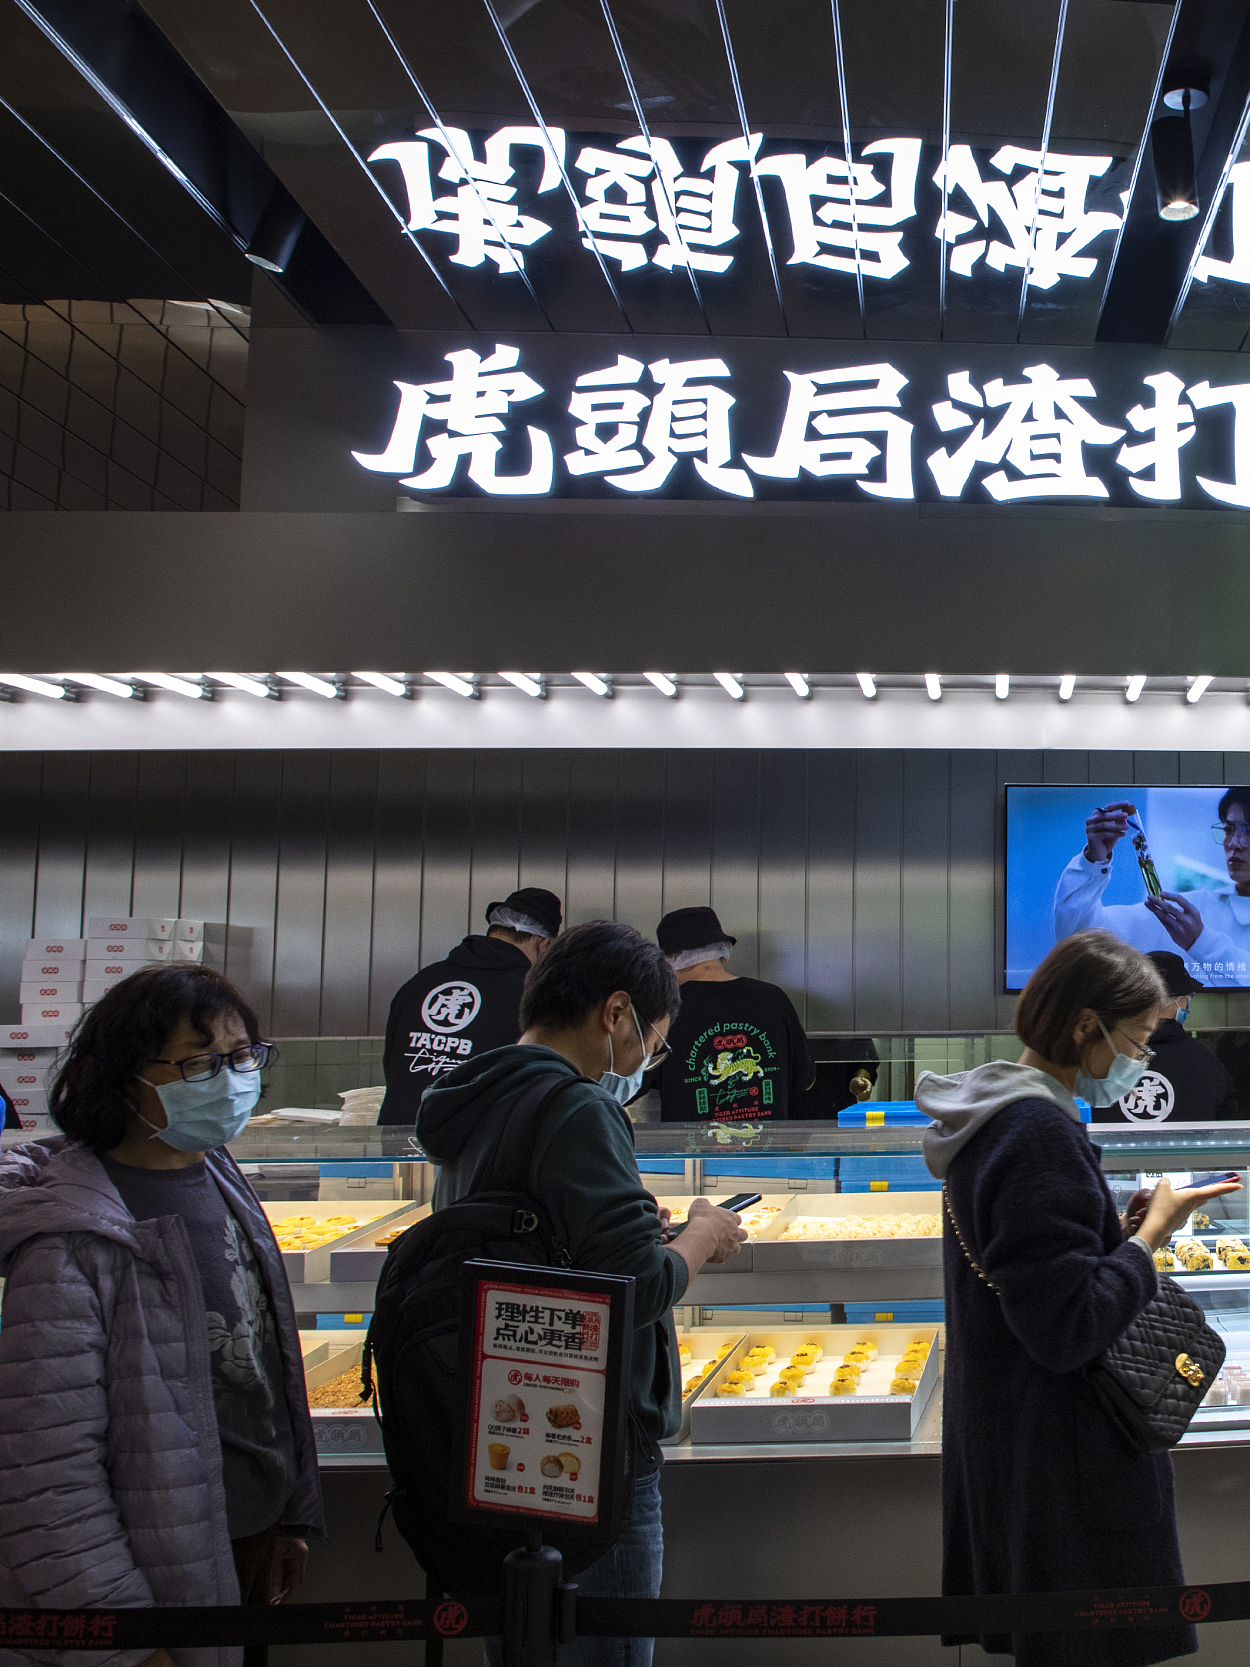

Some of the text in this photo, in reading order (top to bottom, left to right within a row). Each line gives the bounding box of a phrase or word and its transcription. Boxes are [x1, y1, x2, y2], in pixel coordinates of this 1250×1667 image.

[685, 1022, 777, 1071] chartered pastry bank
[731, 1106, 759, 1114] ATTITUDE
[494, 1301, 584, 1330] 理性下单
[493, 1323, 584, 1351] 点心更香
[524, 1372, 580, 1389] 每人每天限购
[0, 1612, 116, 1639] 渣打餅行
[324, 1621, 369, 1629] CHARTERED
[689, 1603, 877, 1627] 虎頭局渣打餅行
[52, 1638, 86, 1646] PASTRY
[88, 1638, 113, 1646] BANK
